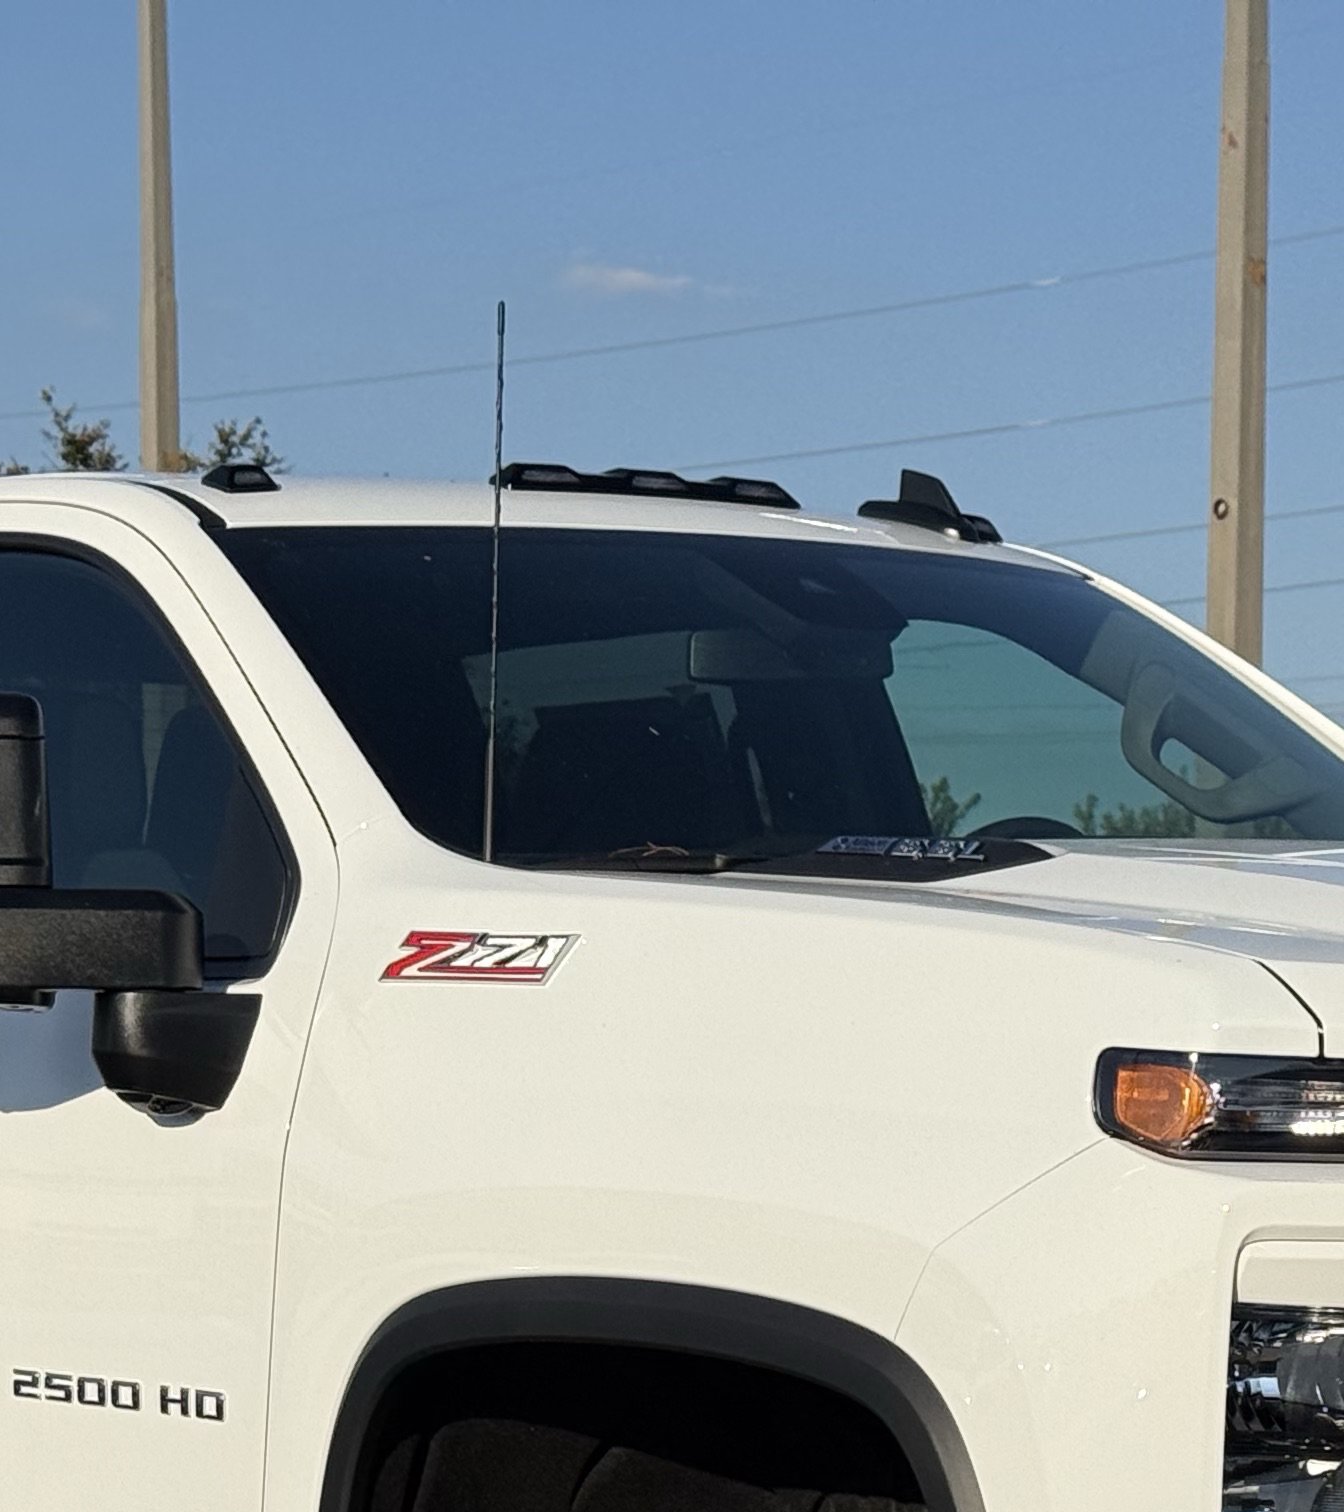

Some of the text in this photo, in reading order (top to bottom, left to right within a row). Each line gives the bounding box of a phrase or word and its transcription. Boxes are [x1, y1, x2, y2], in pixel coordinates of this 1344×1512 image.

[378, 930, 581, 987] Z71
[12, 1368, 226, 1422] 2500 HD
